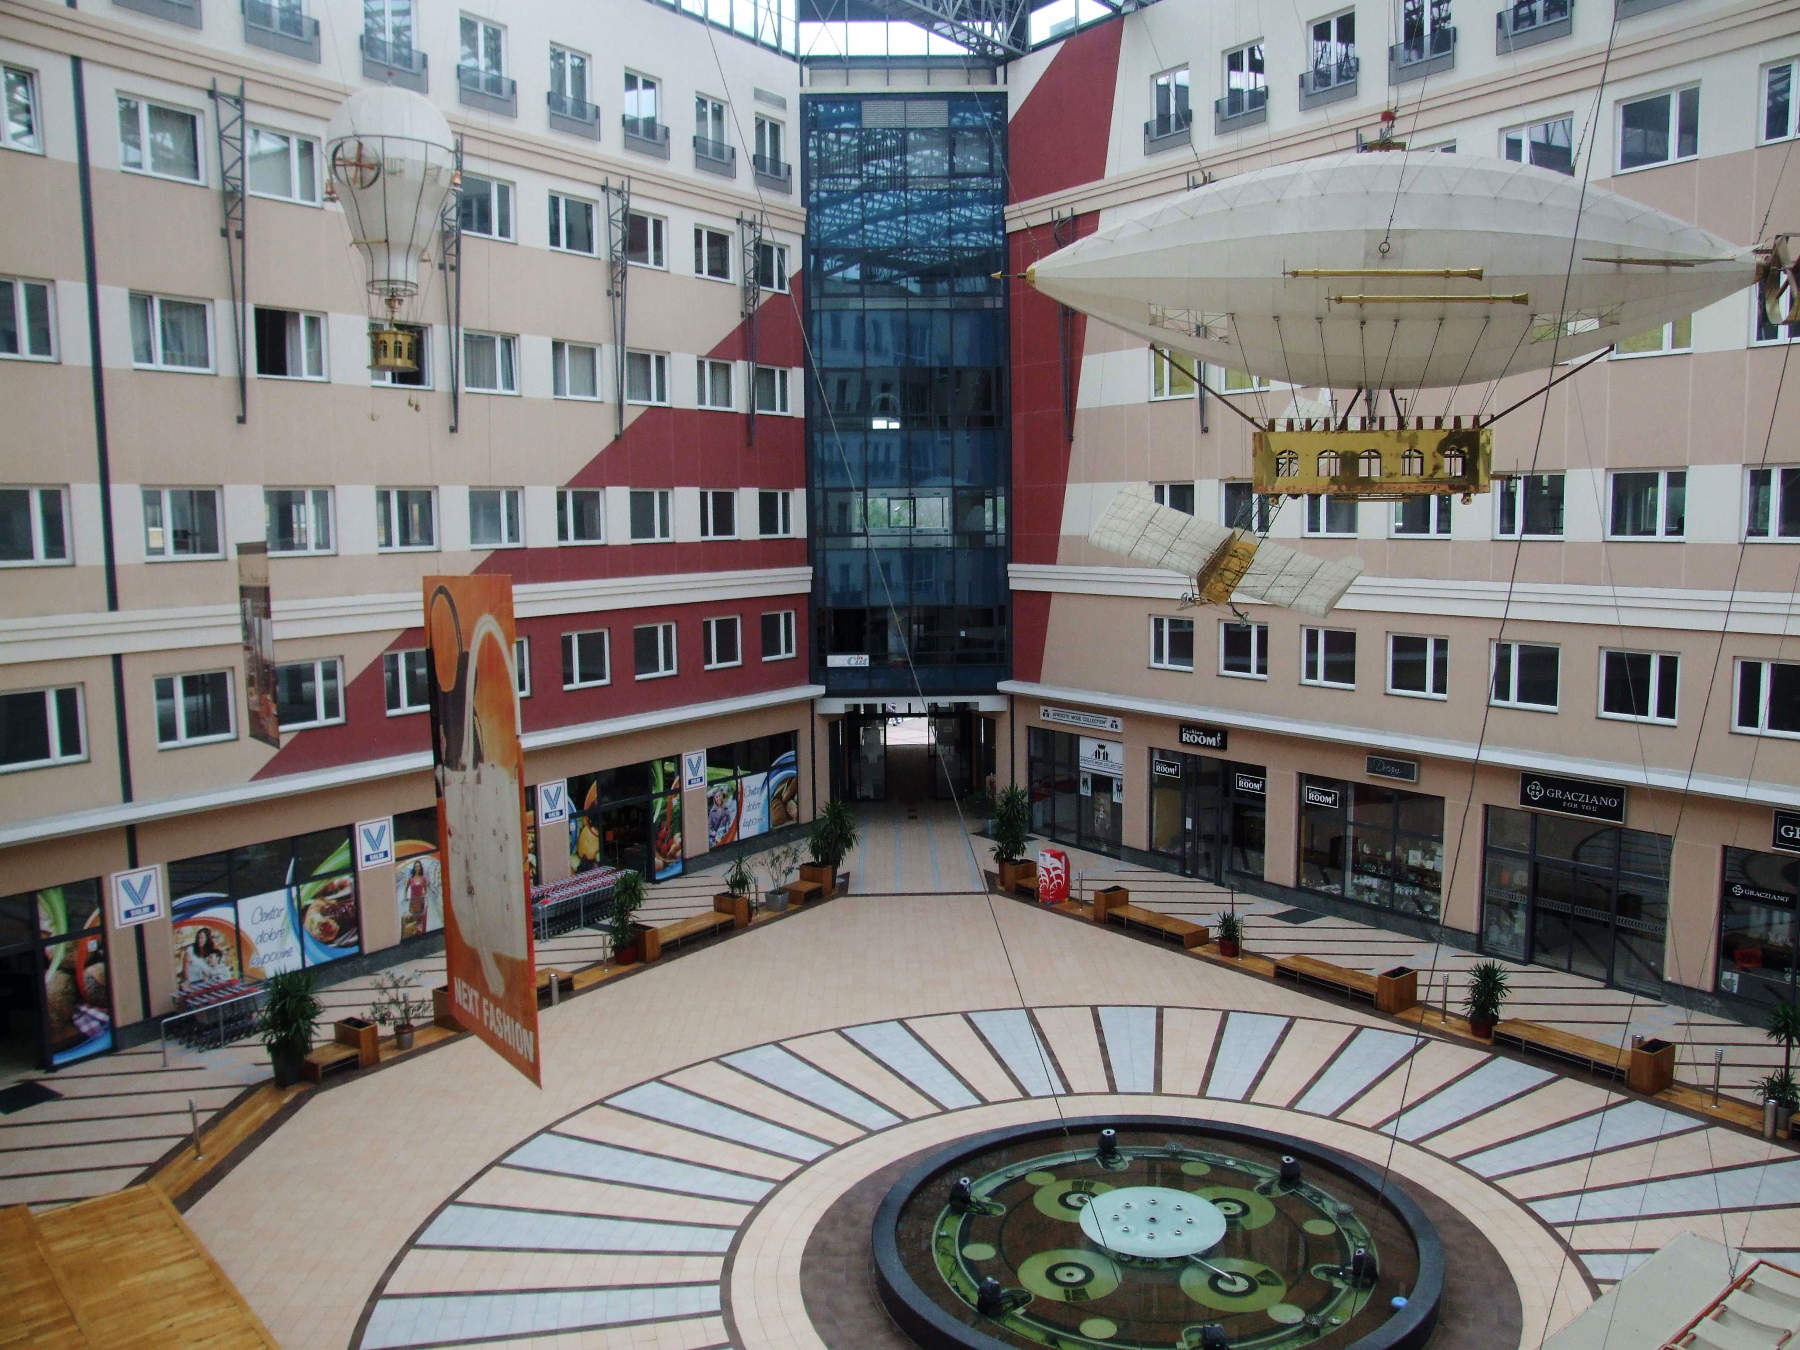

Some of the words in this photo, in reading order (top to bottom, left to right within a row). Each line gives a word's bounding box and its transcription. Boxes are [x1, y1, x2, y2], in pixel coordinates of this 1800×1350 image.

[1182, 732, 1216, 747] ROOM
[1156, 763, 1175, 775] ROOM
[1238, 780, 1260, 791] ROOM
[1308, 792, 1332, 804] ROOM
[1546, 788, 1618, 808] GRACZIANO
[1562, 801, 1578, 809] FOR
[1581, 804, 1597, 812] YOU
[1744, 889, 1789, 903] GRACZIANO
[454, 975, 480, 1020] NEXT
[482, 996, 535, 1064] FASHION
